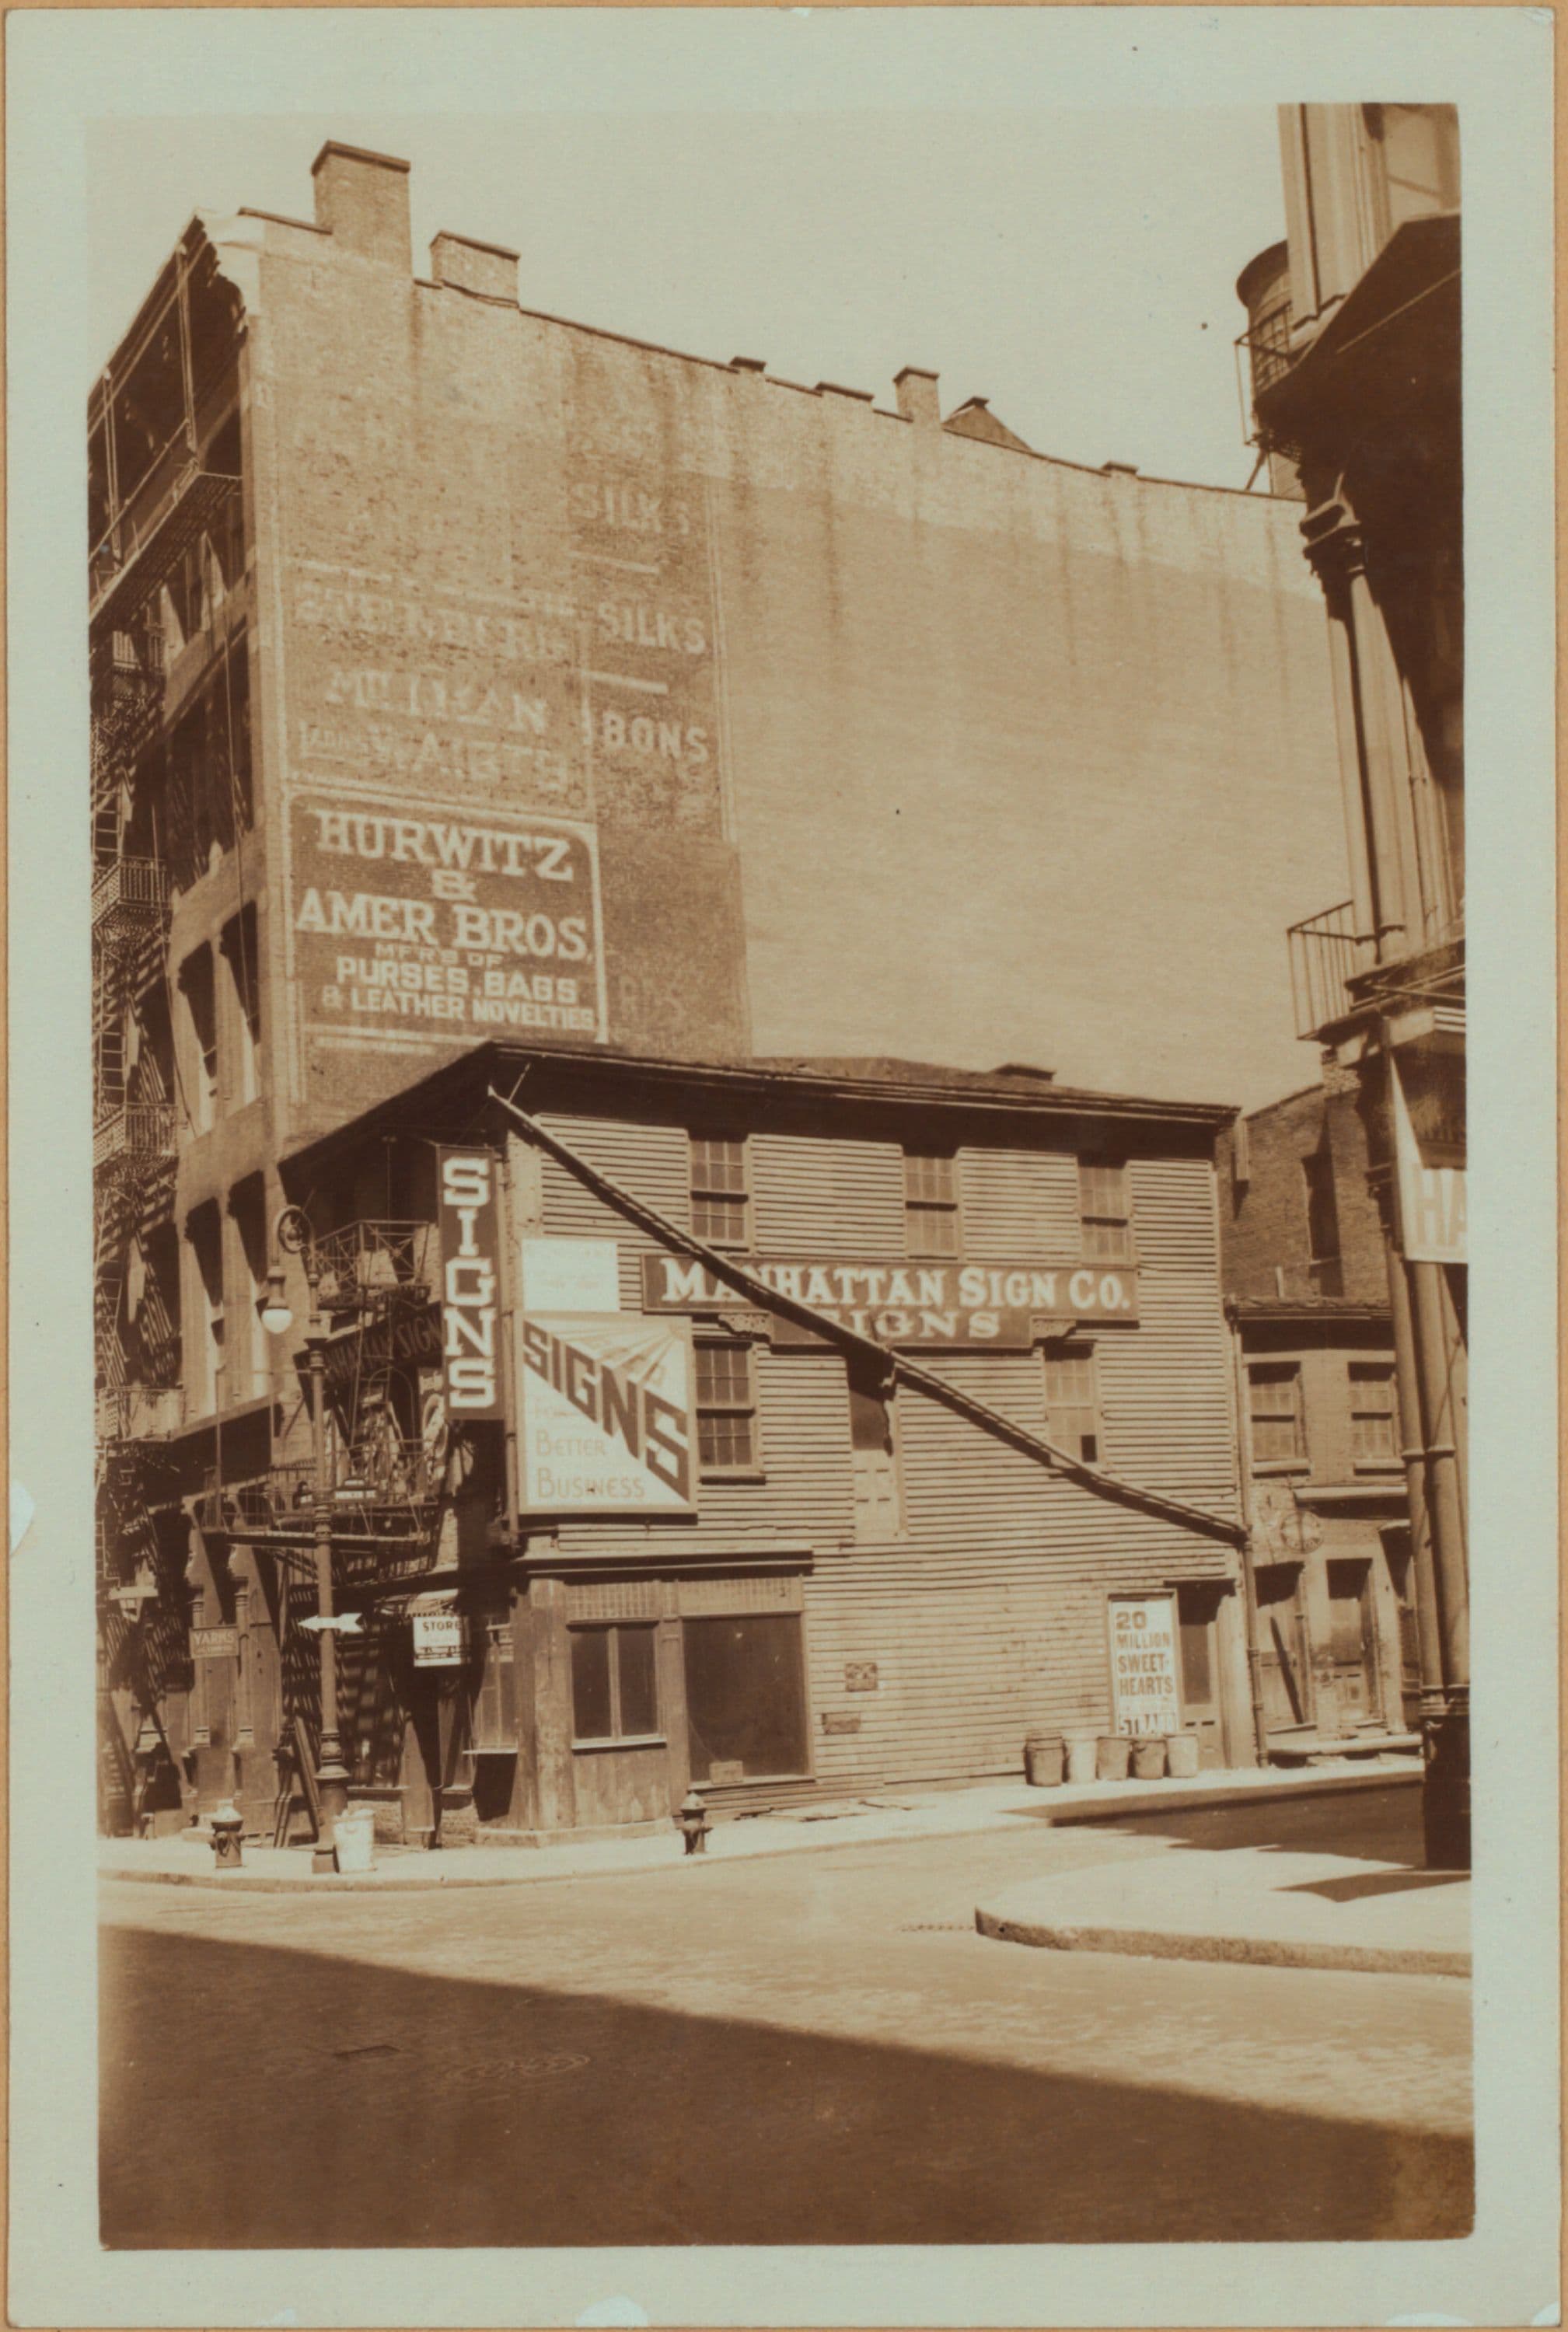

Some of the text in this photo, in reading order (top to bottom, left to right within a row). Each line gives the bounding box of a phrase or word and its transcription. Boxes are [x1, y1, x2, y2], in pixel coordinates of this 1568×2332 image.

[598, 600, 706, 655] SILKS
[311, 808, 574, 882] HURWITZ
[431, 867, 480, 902] &
[295, 886, 440, 946] AMER
[466, 950, 505, 970] OF
[483, 970, 578, 1004] BAGS
[321, 983, 595, 1032] & LEATHER NOVELTIES
[442, 1157, 497, 1409] SIGNS
[957, 1265, 1057, 1309] SIGN
[523, 1321, 690, 1503] SIGNS
[536, 1429, 606, 1457] BETTER
[537, 1467, 645, 1499] BUSINESS
[422, 1620, 463, 1632] STORE
[1116, 1611, 1147, 1631] 20
[1117, 1632, 1171, 1649] MILLION
[1119, 1676, 1175, 1697] HEARTS
